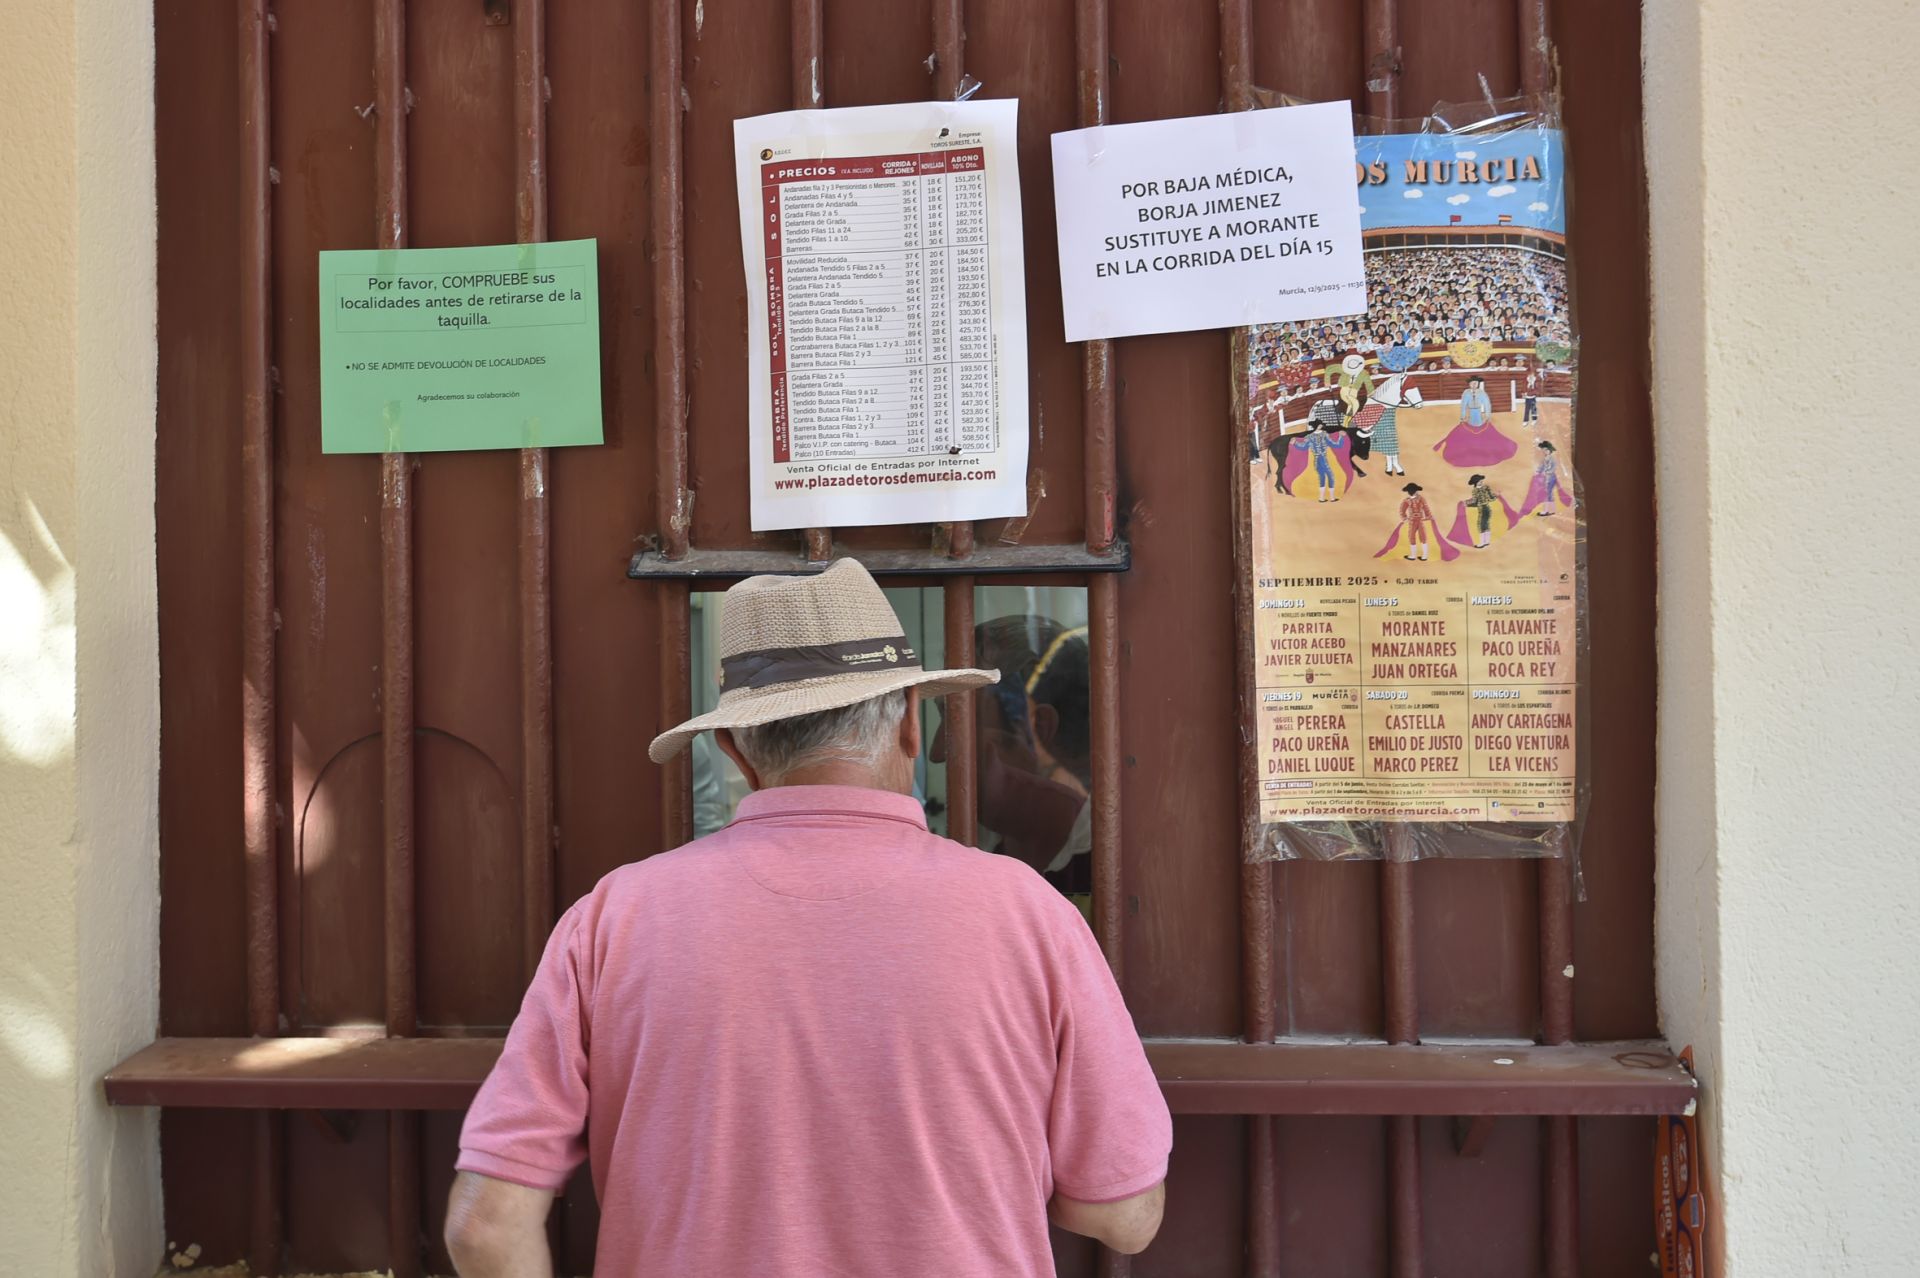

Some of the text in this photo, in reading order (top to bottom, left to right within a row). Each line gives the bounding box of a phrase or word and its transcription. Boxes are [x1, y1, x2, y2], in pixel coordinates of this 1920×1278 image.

[951, 154, 979, 163] ABONO
[779, 167, 836, 178] PRECIOS
[885, 167, 915, 175] REJONES
[1403, 155, 1541, 184] MURCIA
[955, 175, 976, 183] 151,20
[1121, 166, 1294, 199] POR BAJA MÉDICA,
[955, 184, 976, 192] 173,70
[1138, 193, 1281, 223] BORJA JIMENEZ
[1105, 213, 1320, 252] SUSTITUYE A MORANTE
[1096, 237, 1333, 278] EN LA CORRIDA DEL DÍA 15
[368, 272, 555, 291] Por favor, COMPRUEBE sus
[1279, 287, 1306, 295] Murcia,
[1308, 284, 1340, 293] 12/9/2025
[340, 289, 582, 310] localidades antes de retirarse de la
[438, 313, 491, 329] taquilla.
[352, 356, 546, 371] NO SE ADMITE DEVOLUCIÓN DE LOCALIDADES
[417, 394, 465, 402] Agradecemos
[476, 391, 520, 399] colaboración
[787, 458, 980, 474] Venta Oficial de Entradas por Internet
[775, 469, 996, 490] www.plazadetorosdemurcia.com
[1258, 577, 1342, 588] SEPTIEMBRE
[1347, 576, 1378, 586] 2025
[1260, 599, 1305, 609] DOMINGO 14
[1364, 598, 1389, 607] LUNES
[1389, 598, 1398, 607] 15
[1472, 595, 1503, 605] MARTES
[1282, 622, 1333, 634] PARRITA
[1382, 621, 1445, 636] MORANTE
[1486, 619, 1557, 635] TALAVANTE
[1271, 638, 1346, 650] VICTOR ACEBO
[1372, 642, 1457, 657] MANZANARES
[1482, 638, 1561, 656] PACO UREÑA
[1264, 653, 1353, 666] JAVIER ZULUETA
[1372, 663, 1458, 679] JUAN ORTEGA
[1488, 661, 1556, 678] ROCA REY
[1264, 692, 1303, 702] VIERNES 19
[1366, 691, 1409, 700] SABADO 20
[1472, 690, 1510, 699] DOMINGO
[1511, 690, 1520, 699] 21
[1297, 715, 1346, 731] PERERA
[1385, 714, 1446, 730] CASTELLA
[1471, 713, 1573, 729] ANDY CARTAGENA
[1272, 733, 1350, 753] PACO UREÑA
[1369, 735, 1463, 751] EMILIO DE JUSTO
[1475, 734, 1570, 750] DIEGO VENTURA
[1268, 757, 1355, 774] DANIEL LUQUE
[1374, 757, 1459, 773] MARCO PEREZ
[1489, 756, 1559, 772] LEA VICENS
[1269, 806, 1480, 816] www.plazadetorosdemurcia.com
